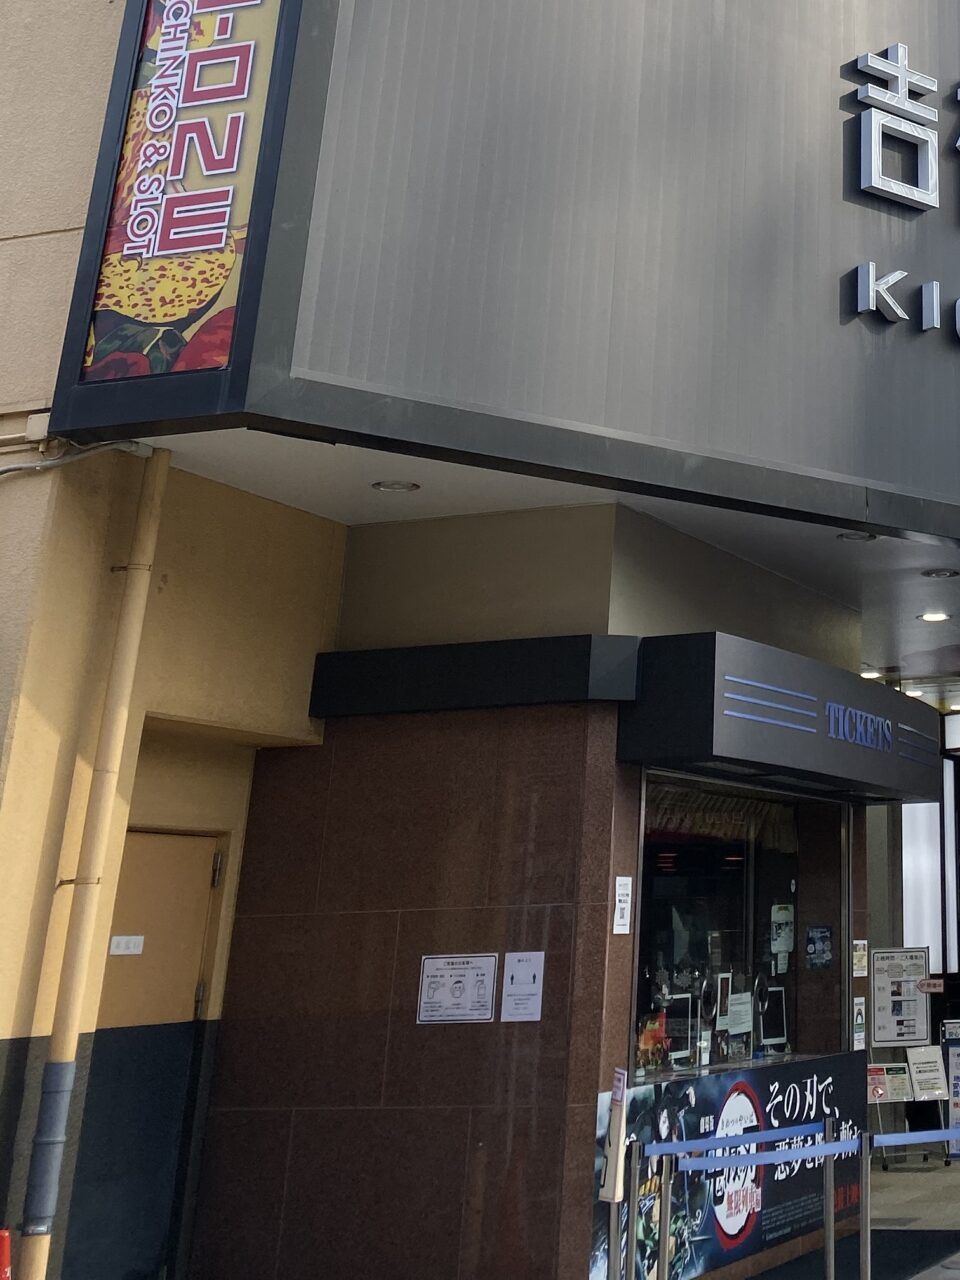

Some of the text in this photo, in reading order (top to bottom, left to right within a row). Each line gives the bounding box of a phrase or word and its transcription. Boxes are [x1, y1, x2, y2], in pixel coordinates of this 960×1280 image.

[138, 141, 171, 172] &
[122, 175, 163, 258] SLOT
[825, 702, 893, 752] TICKETS
